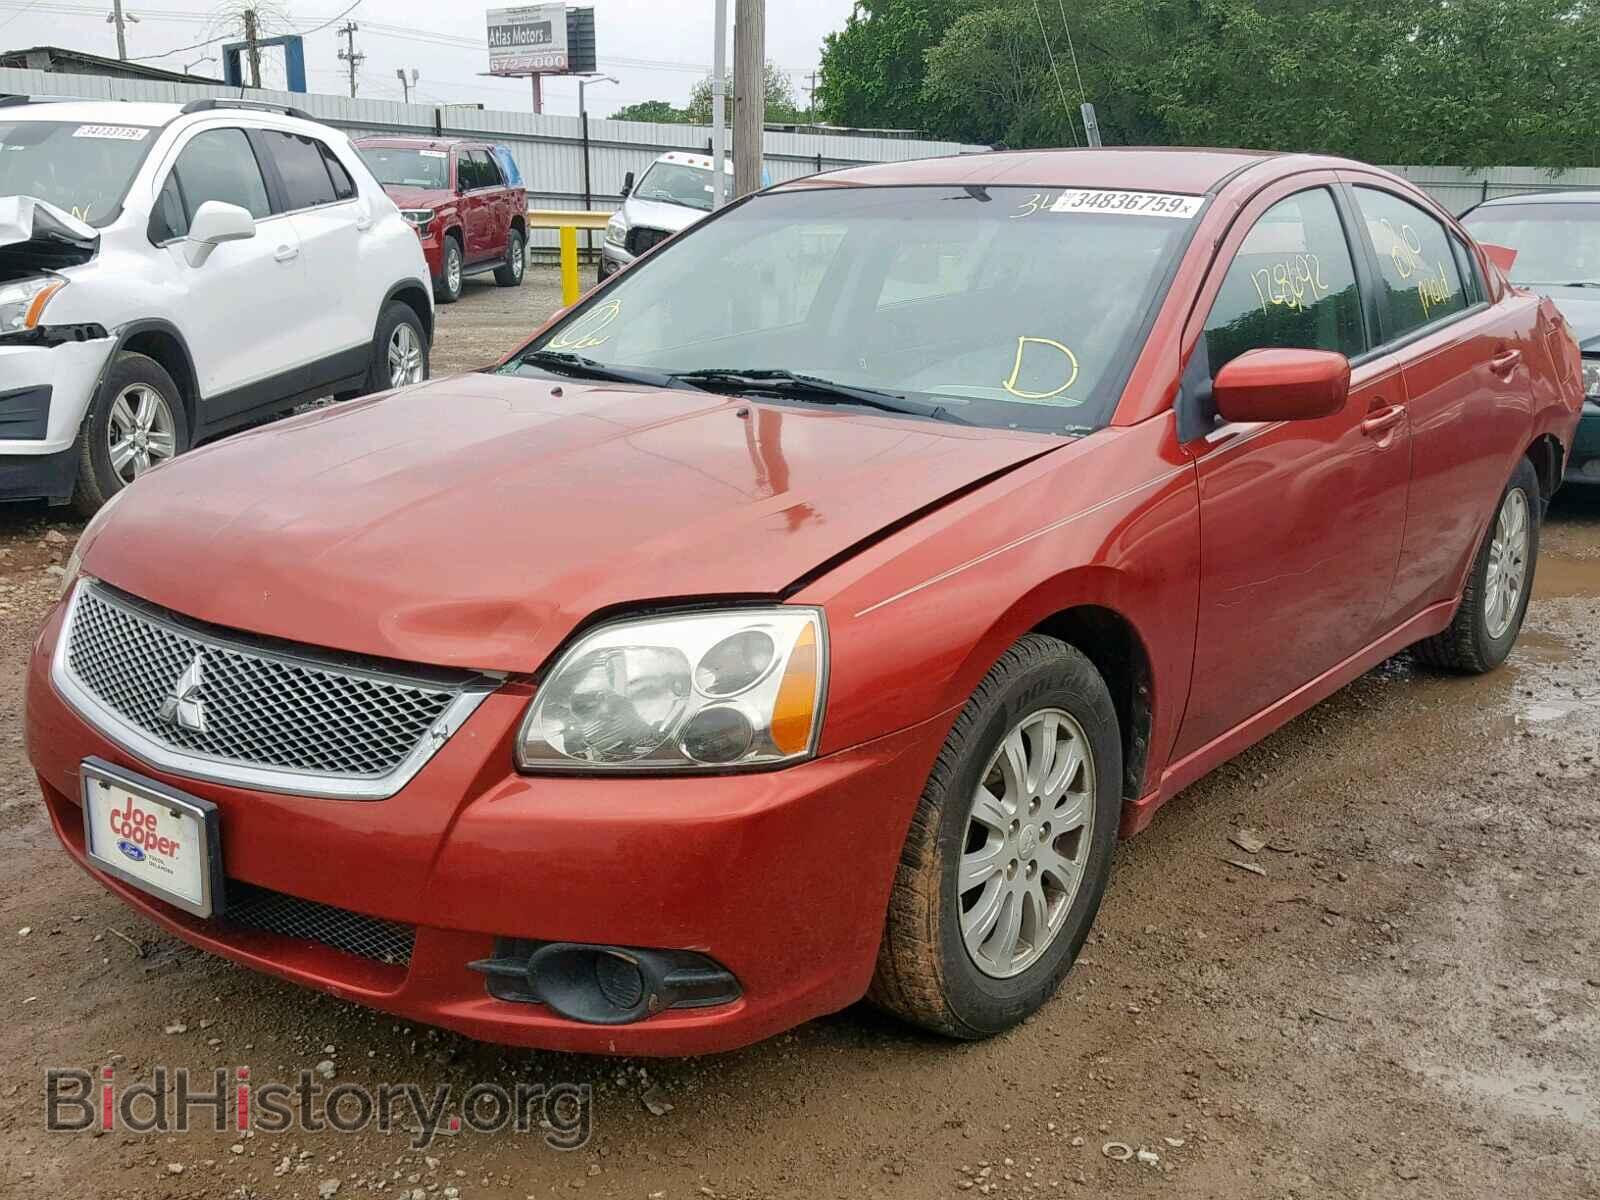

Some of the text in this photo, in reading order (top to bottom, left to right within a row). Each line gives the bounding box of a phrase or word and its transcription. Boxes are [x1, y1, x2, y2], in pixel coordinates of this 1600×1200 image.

[488, 26, 511, 46] Atlas
[512, 25, 543, 45] Motors
[1002, 336, 1079, 399] D
[110, 808, 180, 858] Cooper
[122, 797, 157, 832] Joe
